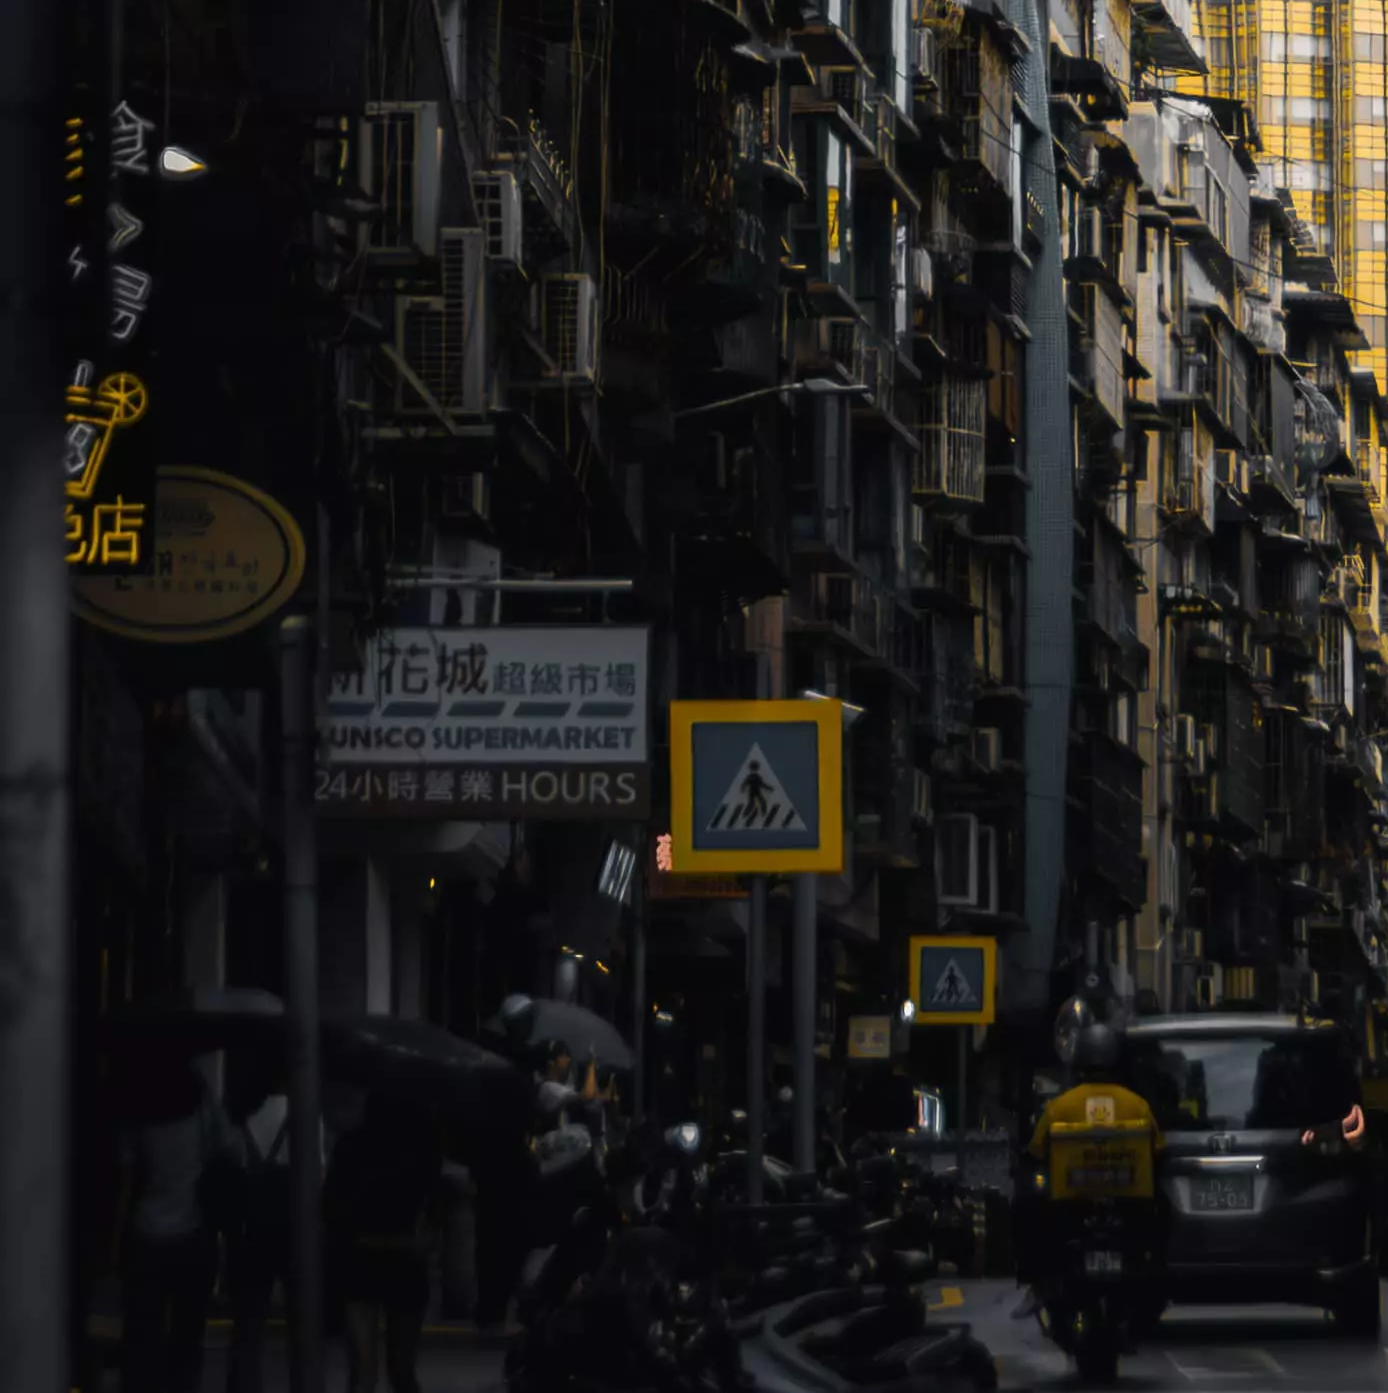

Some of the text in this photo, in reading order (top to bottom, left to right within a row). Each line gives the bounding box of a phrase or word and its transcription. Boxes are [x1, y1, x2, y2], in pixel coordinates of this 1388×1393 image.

[492, 661, 637, 697] 超級市場
[326, 725, 637, 751] UNSCO SUPERMARKET
[501, 771, 637, 804] HOURS
